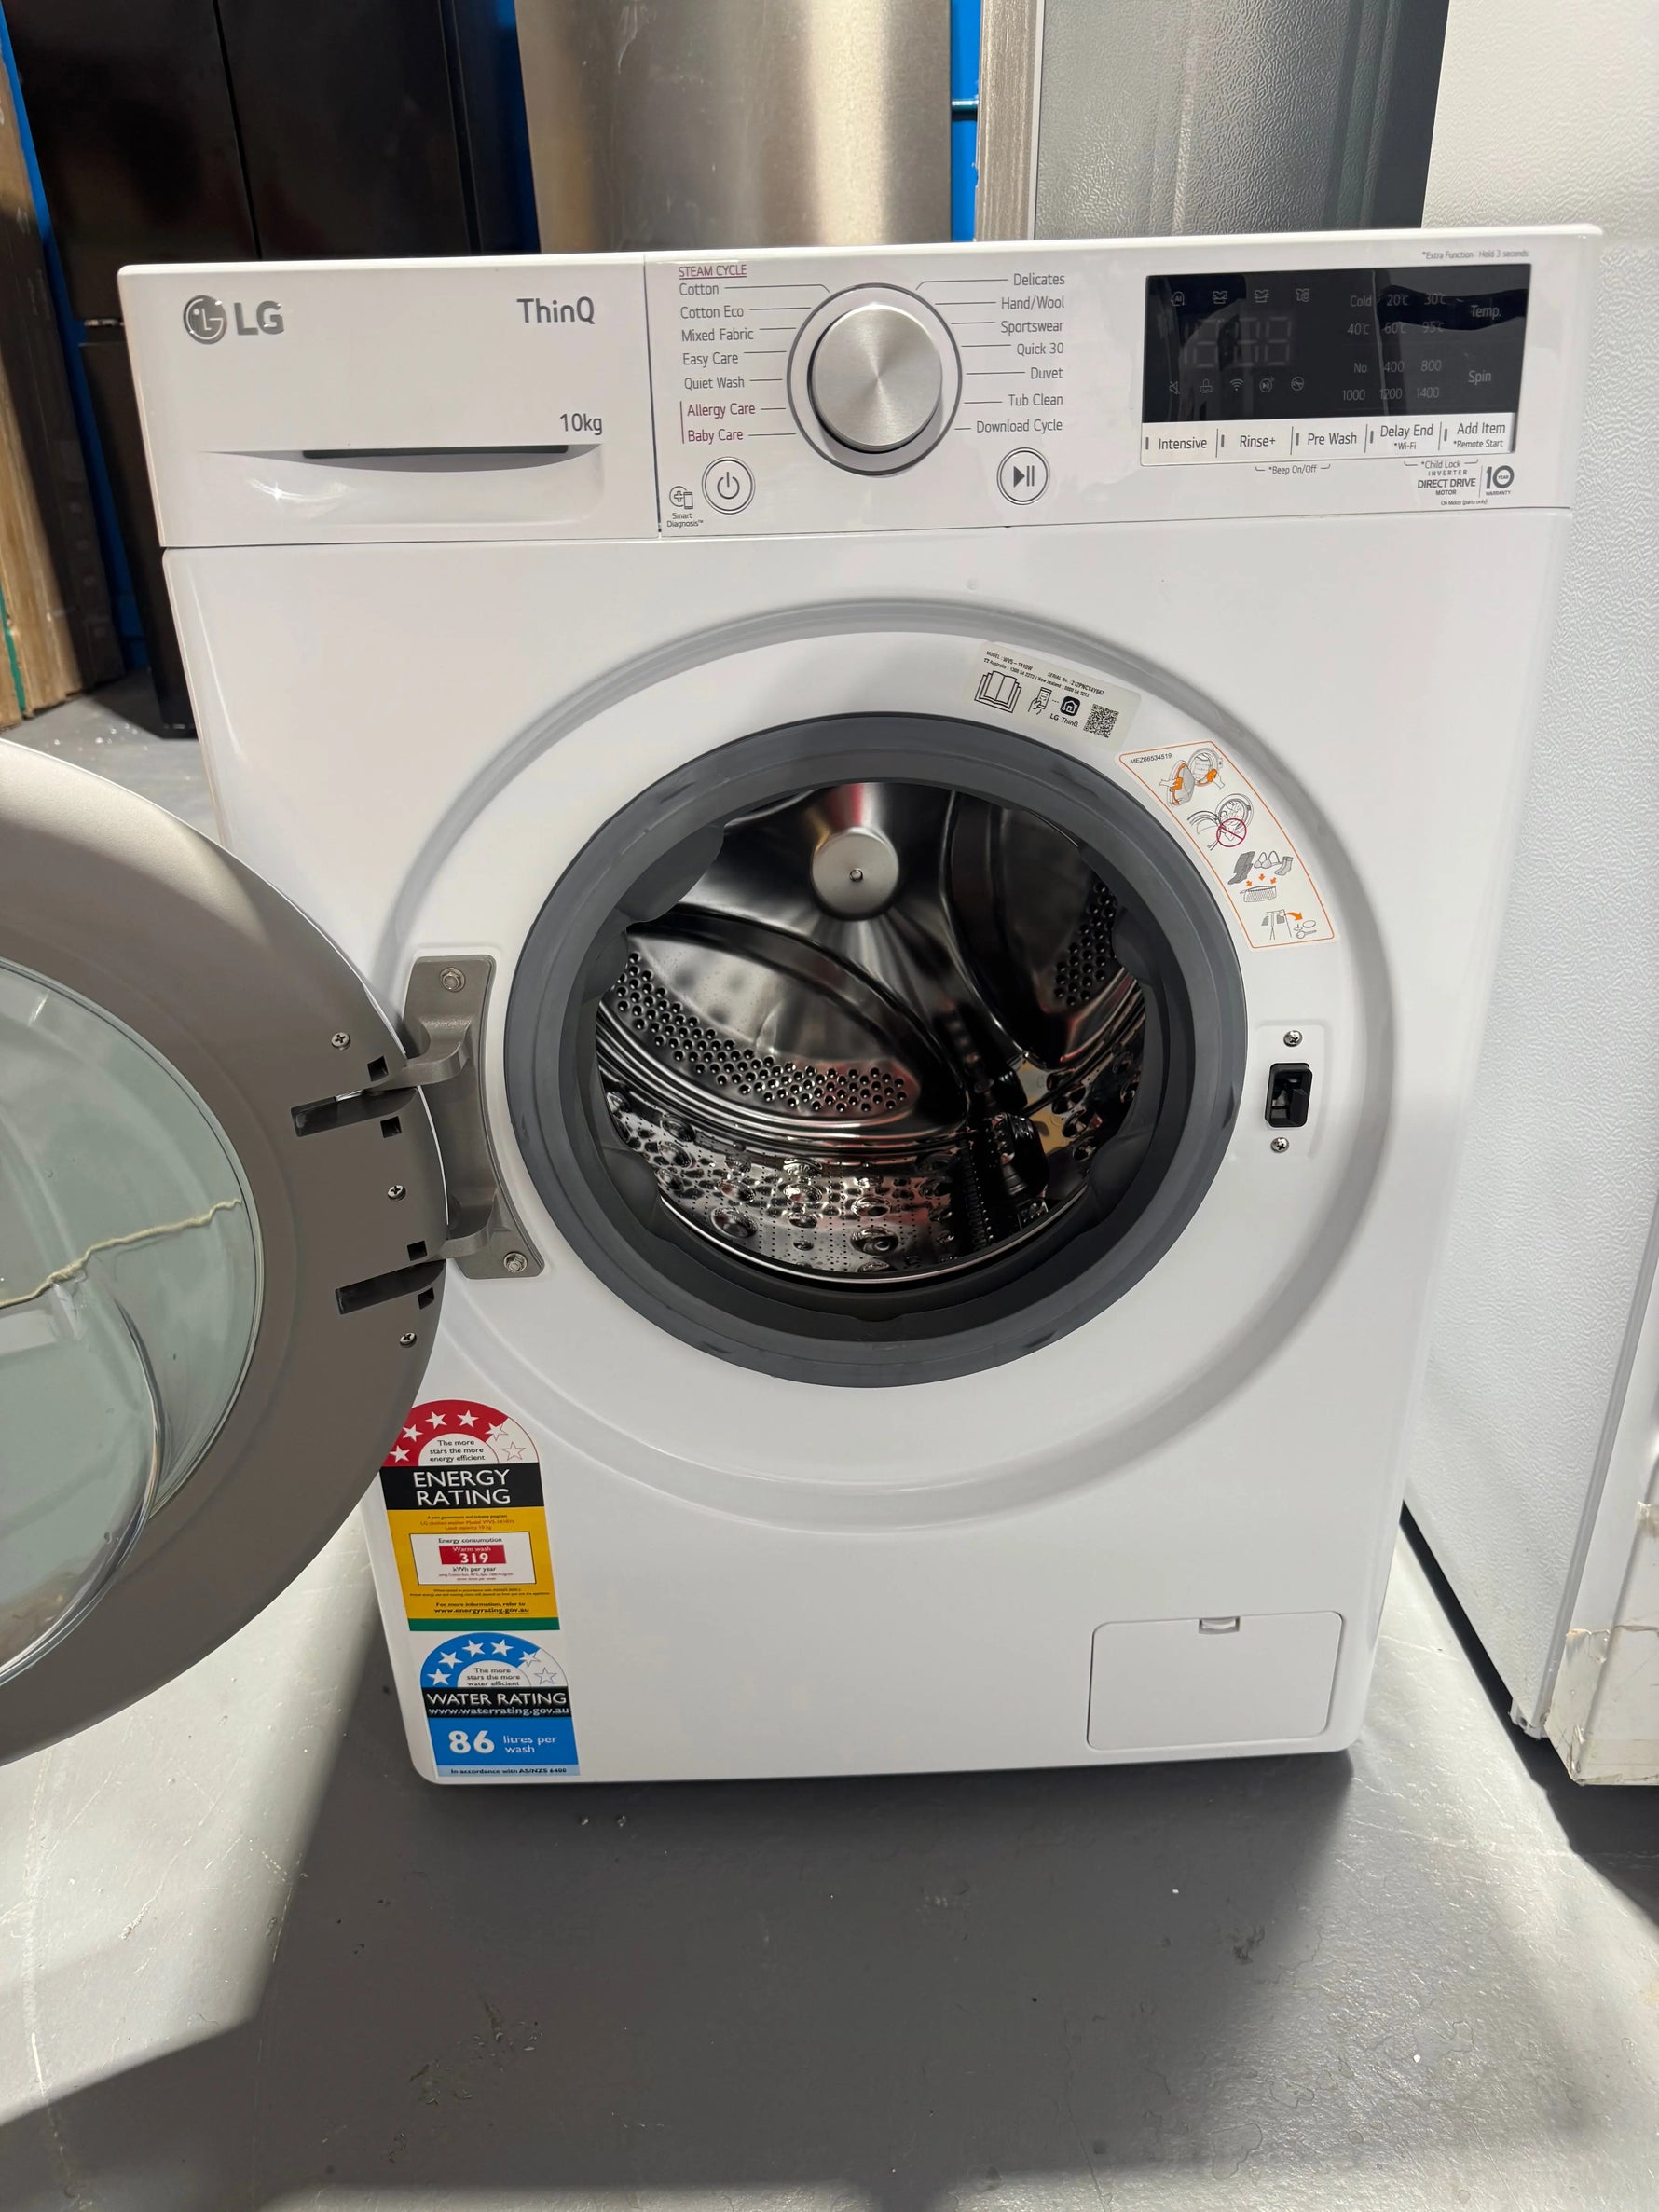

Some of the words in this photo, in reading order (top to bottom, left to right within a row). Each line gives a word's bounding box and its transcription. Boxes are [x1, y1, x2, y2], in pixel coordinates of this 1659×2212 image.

[1446, 251, 1474, 259] Function
[679, 266, 713, 277] STEAM
[716, 264, 747, 276] CYCLE
[1013, 273, 1065, 286] Delicates
[679, 283, 720, 295] Cotton
[1001, 295, 1064, 310] Hand/Wool
[1350, 295, 1372, 307] Cold
[516, 296, 596, 324] ThinQ
[680, 306, 720, 320] Cotton
[723, 306, 744, 318] Eco
[1471, 305, 1502, 319] Temp.
[233, 300, 284, 337] LG
[681, 328, 715, 342] Mixed
[720, 327, 754, 341] Fabric
[1001, 321, 1064, 336] Sportswear
[1017, 343, 1047, 357] Quick
[1049, 343, 1064, 354] 30
[682, 352, 708, 368] Easy
[712, 351, 739, 364] Care
[1031, 367, 1063, 379] Duvet
[1353, 363, 1367, 373] No
[1420, 360, 1442, 372] 800
[684, 378, 713, 391] Quiet
[717, 376, 745, 389] Wash
[1468, 370, 1491, 386] Spin
[1008, 394, 1029, 406] Tub
[1033, 393, 1063, 406] Clean
[1342, 389, 1365, 401] 1000
[1417, 387, 1440, 398] 1400
[687, 403, 726, 419] Allergy
[730, 402, 756, 415] Care
[560, 413, 602, 436] 10kg
[977, 419, 1030, 433] Download
[1034, 419, 1063, 434] Cycle
[1457, 422, 1478, 434] Add
[1482, 422, 1506, 434] Item
[688, 430, 714, 445] Baby
[718, 428, 744, 441] Care
[1380, 425, 1410, 440] Delay
[1413, 423, 1433, 436] End
[1159, 436, 1207, 450] Intensive
[1240, 434, 1276, 447] Rinse+
[1308, 433, 1325, 445] Pre
[1329, 432, 1357, 444] Wash
[1485, 439, 1503, 447] Start
[1292, 464, 1317, 474] On/Off
[1445, 460, 1461, 469] Lock
[1418, 479, 1448, 488] DIRECT
[1450, 478, 1476, 488] DRIVE
[1487, 465, 1515, 489] 10
[986, 651, 1000, 659] MODEL
[990, 660, 1007, 669] Australia
[1047, 672, 1062, 680] SERIAL
[1049, 713, 1060, 721] LG
[1061, 716, 1079, 727] ThinQ
[413, 1468, 511, 1489] ENERGY
[417, 1489, 511, 1506] RATING
[459, 1552, 489, 1564] 319
[427, 1693, 492, 1705] WATER
[497, 1693, 567, 1704] RATING
[429, 1707, 569, 1716] www.waterrating.gov.au
[448, 1730, 495, 1754] 86
[503, 1735, 533, 1744] litres
[537, 1736, 557, 1745] per
[505, 1745, 535, 1753] wash
